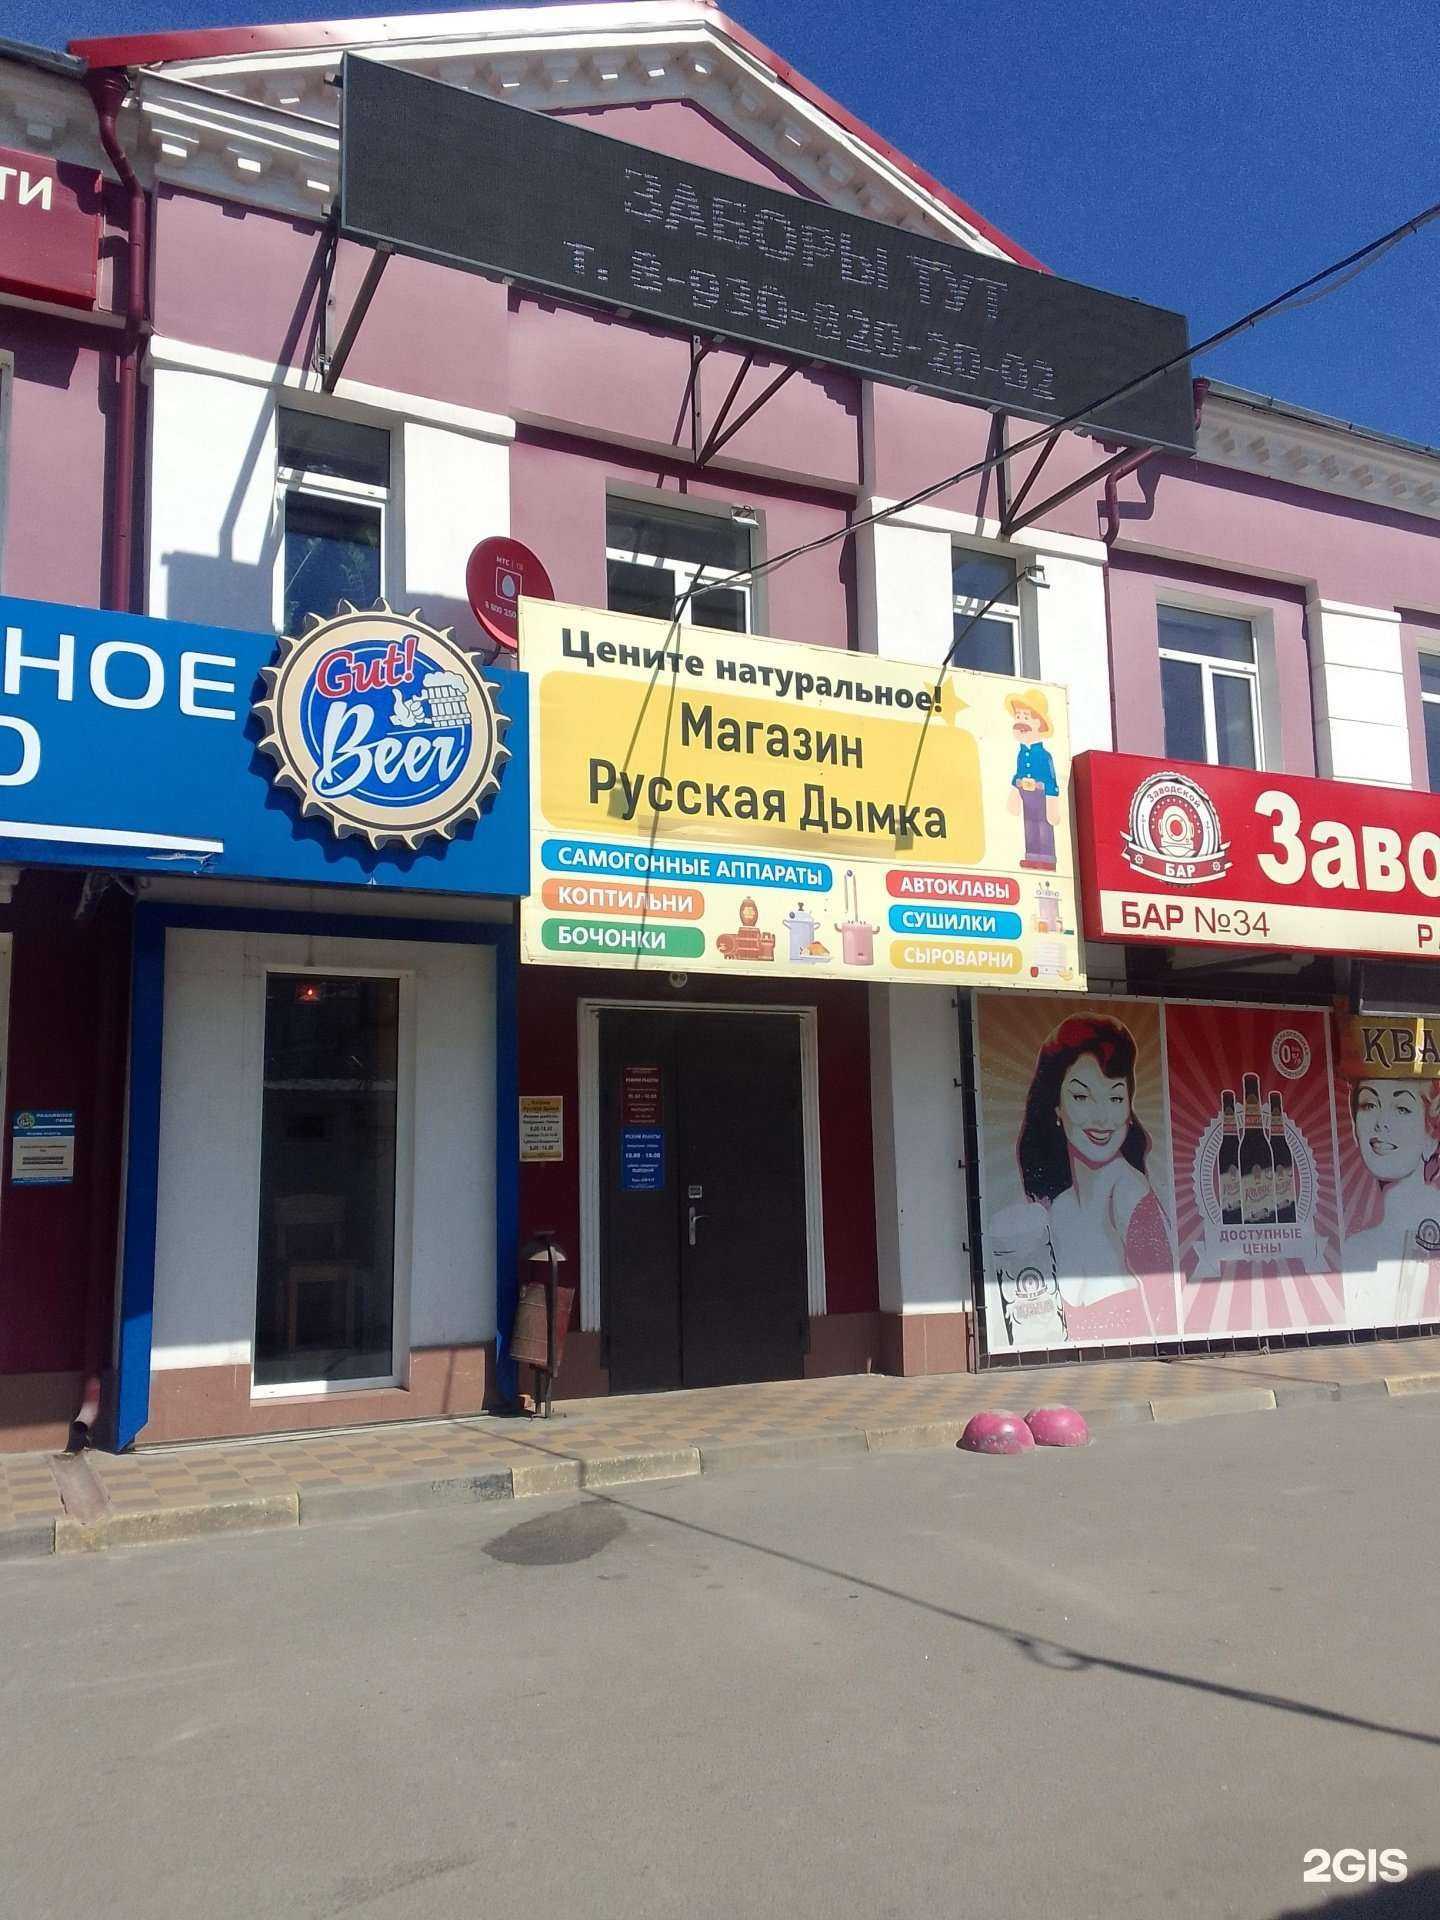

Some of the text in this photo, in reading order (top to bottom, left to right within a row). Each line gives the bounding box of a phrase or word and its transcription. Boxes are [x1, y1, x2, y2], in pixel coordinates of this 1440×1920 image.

[623, 167, 1009, 320] ЗАБОРЫ ТУТ
[3, 627, 236, 721] НОЕ
[316, 634, 419, 699] Gut!
[561, 628, 943, 714] Цените натуральное!
[315, 701, 464, 798] Beer
[681, 702, 864, 769] Магазин
[589, 758, 947, 839] Русская Дымка
[1146, 785, 1201, 809] Заводской
[558, 847, 824, 886] САМОГОННЫЕ АППАРАТЫ
[1165, 862, 1196, 878] БАР
[558, 886, 694, 913] КОПТИЛЬНИ
[900, 876, 1011, 900] АВТОКЛАВЫ
[902, 911, 997, 933] СУШИЛКИ
[1121, 901, 1184, 930] БАР
[1195, 907, 1271, 937] №34
[558, 925, 667, 950] БОЧОНКИ
[903, 946, 1014, 969] СЫРОВАРНИ
[1219, 1228, 1302, 1243] ДОСТУПНЫЕ
[1242, 1242, 1282, 1259] ЦЕНЫ
